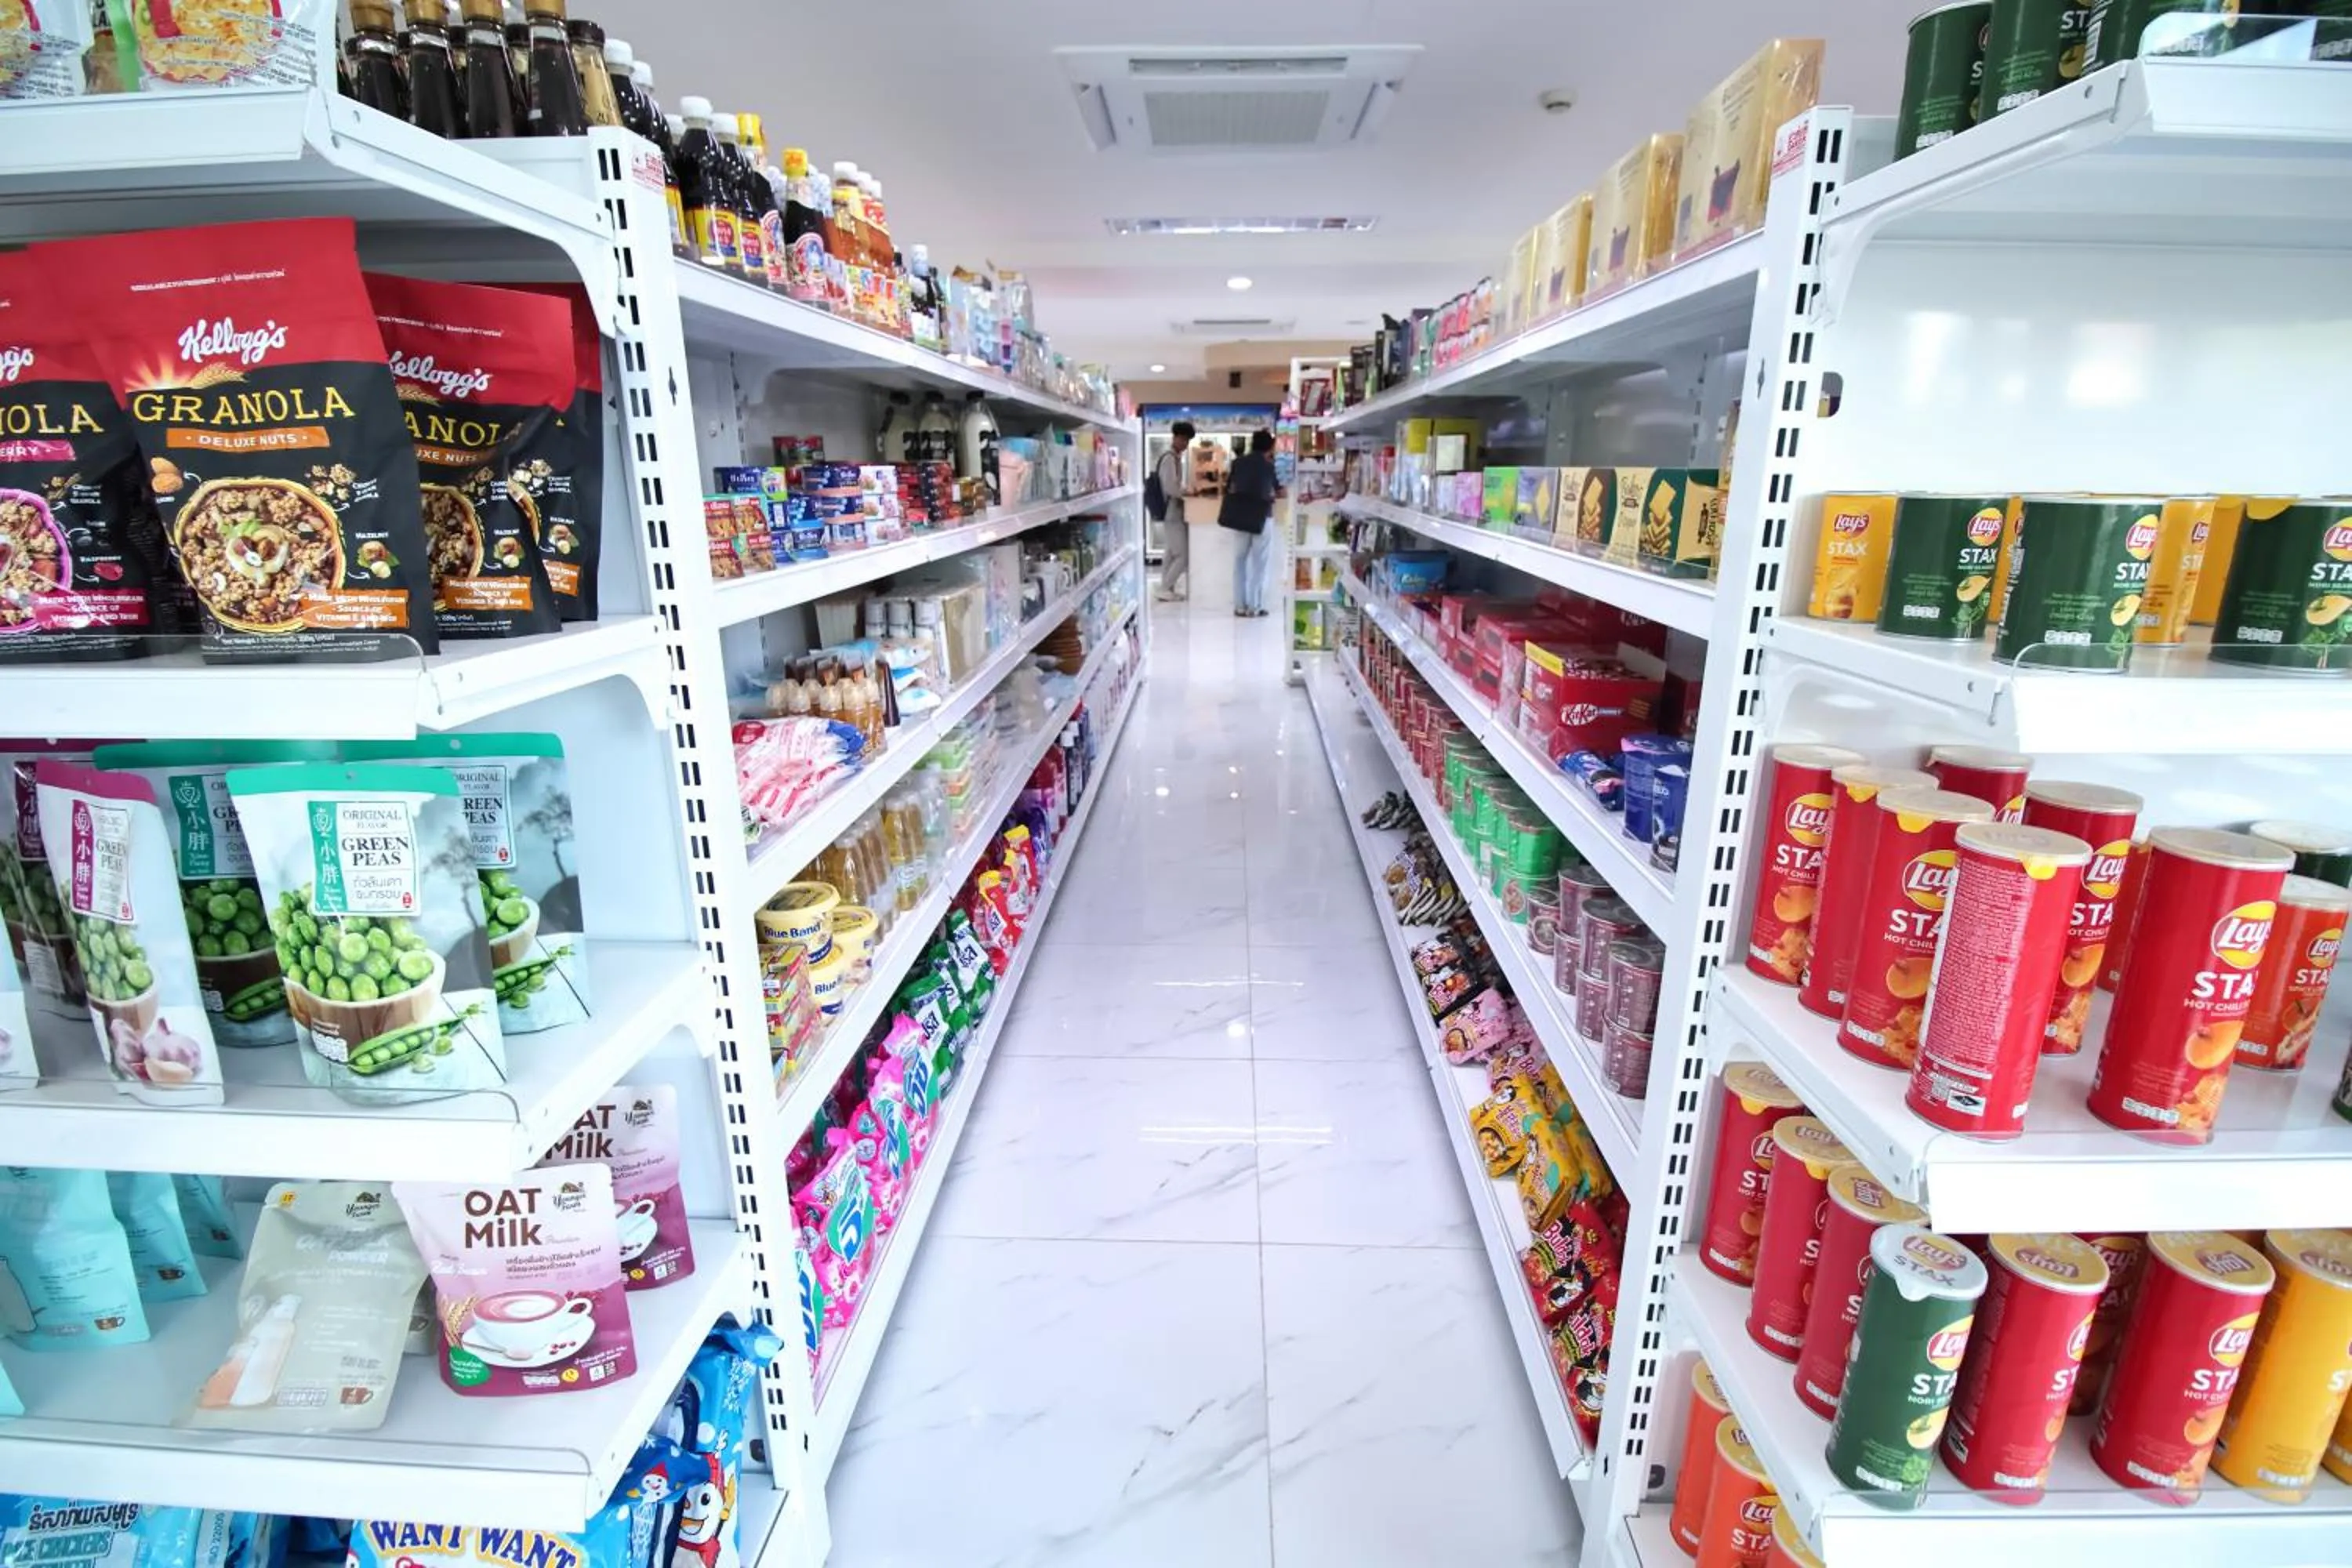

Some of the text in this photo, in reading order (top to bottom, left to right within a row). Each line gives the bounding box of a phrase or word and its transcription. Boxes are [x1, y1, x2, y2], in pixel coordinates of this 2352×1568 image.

[178, 317, 288, 365] Kellogg's
[132, 387, 356, 425] GRANOLA
[198, 433, 298, 448] DELUXE NUTS
[1835, 514, 1870, 532] Lay's
[1826, 541, 1869, 556] STAX
[1958, 548, 1998, 564] STAX
[463, 797, 503, 810] REEN
[342, 809, 402, 821] ORIGINAL
[187, 810, 210, 851] 小胖
[341, 837, 409, 851] GREEN
[352, 851, 402, 866] PEAS
[764, 920, 822, 938] Blue Band
[1883, 932, 1908, 946] HOT
[2295, 967, 2333, 985] STA
[2191, 971, 2259, 1000] STA
[2183, 998, 2214, 1011] HOT
[573, 1104, 616, 1130] AT
[464, 1187, 543, 1217] OAT
[464, 1217, 543, 1249] Milk
[1893, 1254, 1956, 1287] STAX
